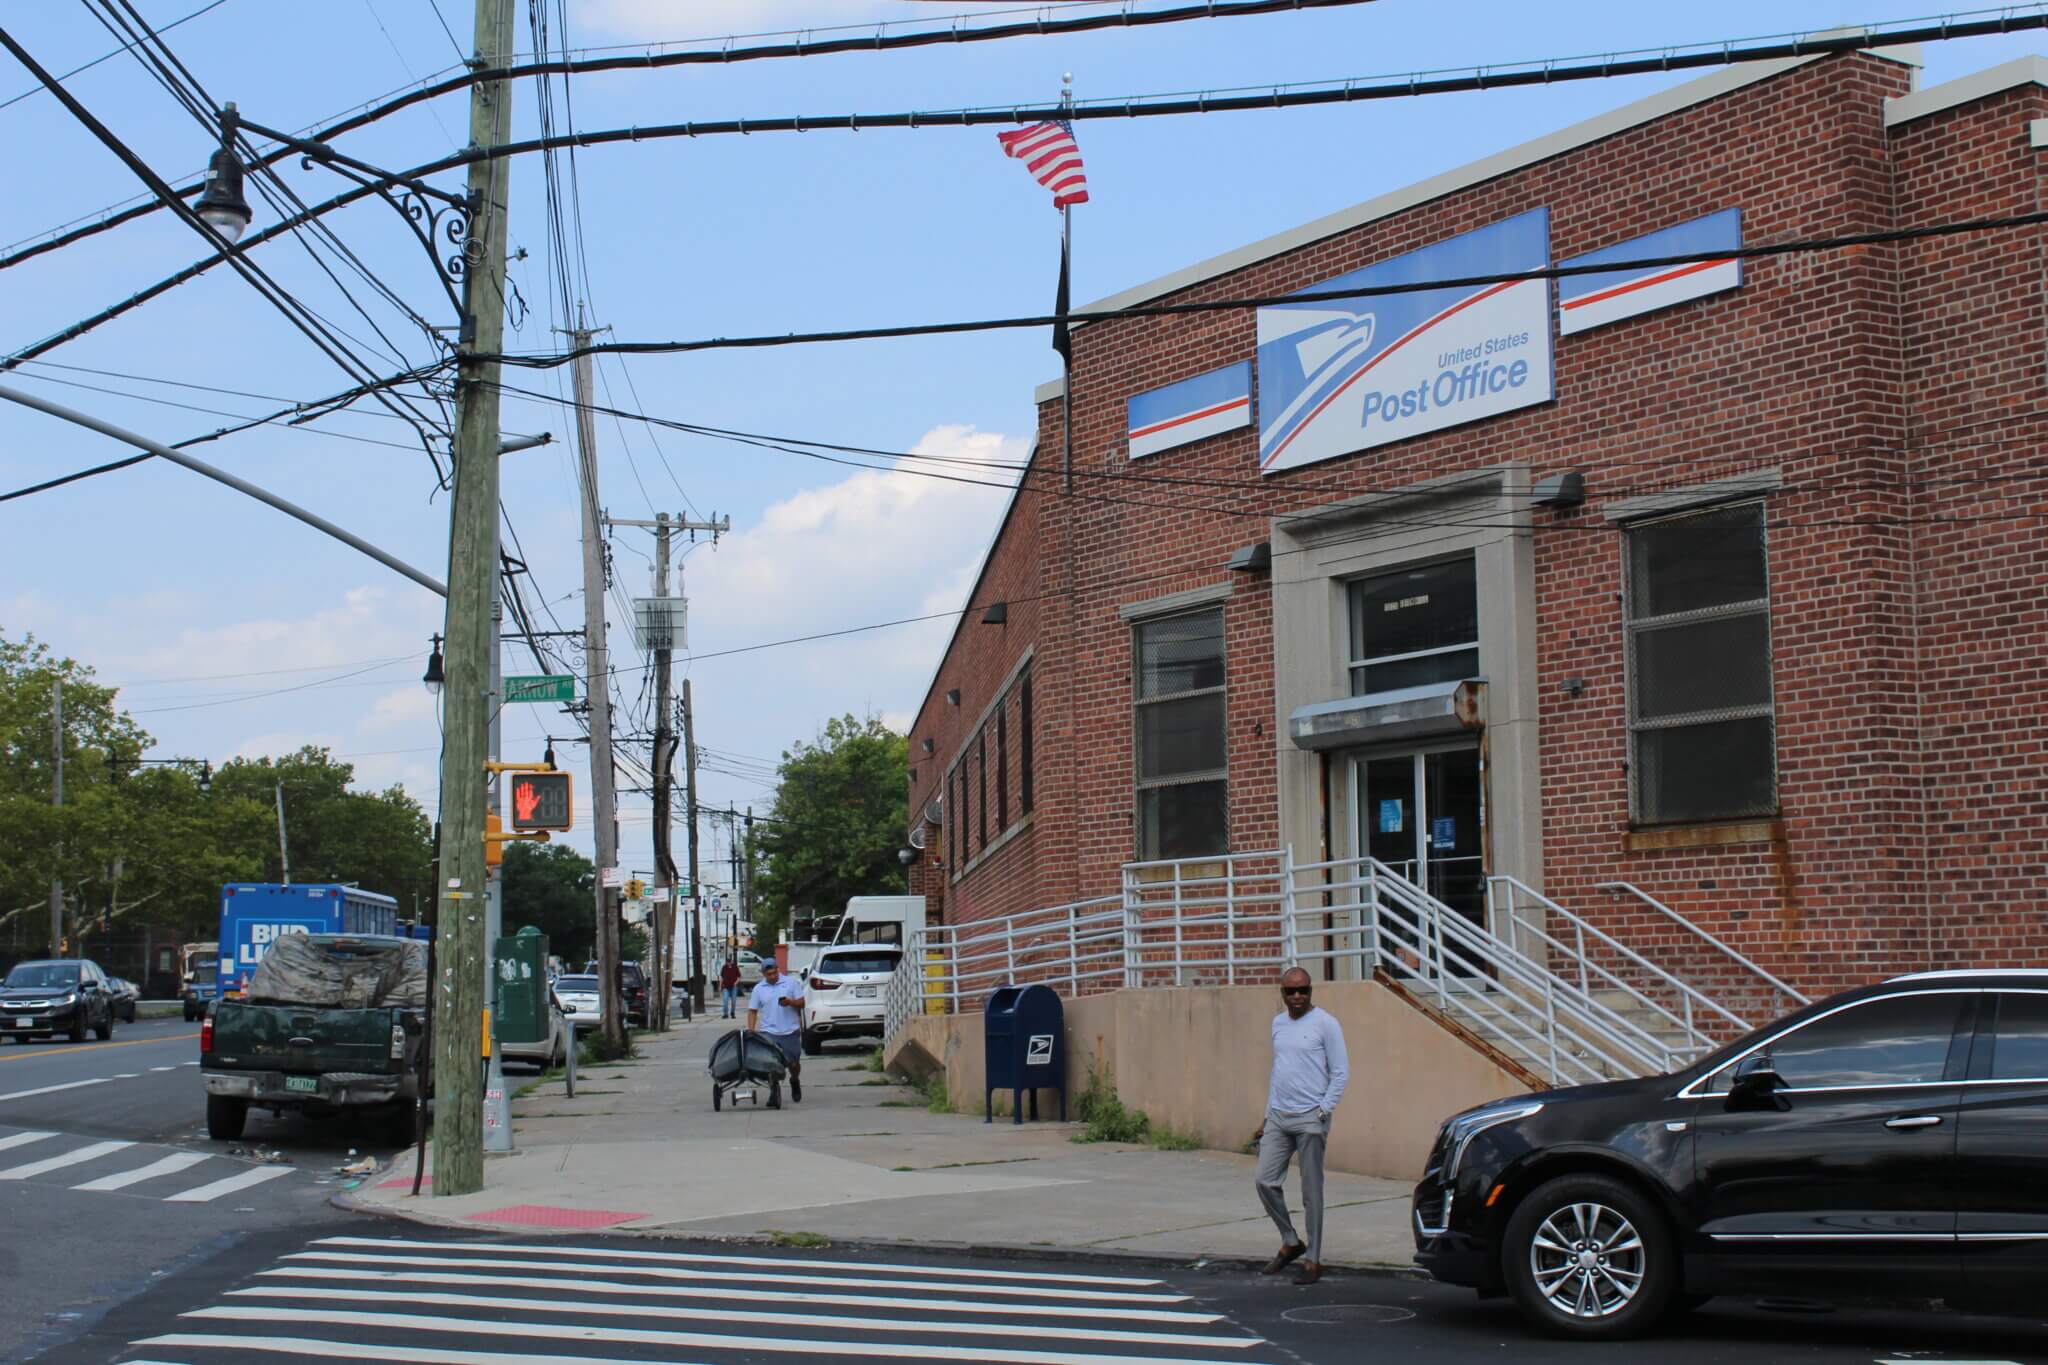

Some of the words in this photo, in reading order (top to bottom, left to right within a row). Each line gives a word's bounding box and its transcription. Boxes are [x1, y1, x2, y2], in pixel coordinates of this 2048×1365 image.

[1438, 342, 1482, 369] United
[1484, 331, 1529, 355] States
[1361, 379, 1430, 429] Post
[1432, 359, 1529, 407] Office
